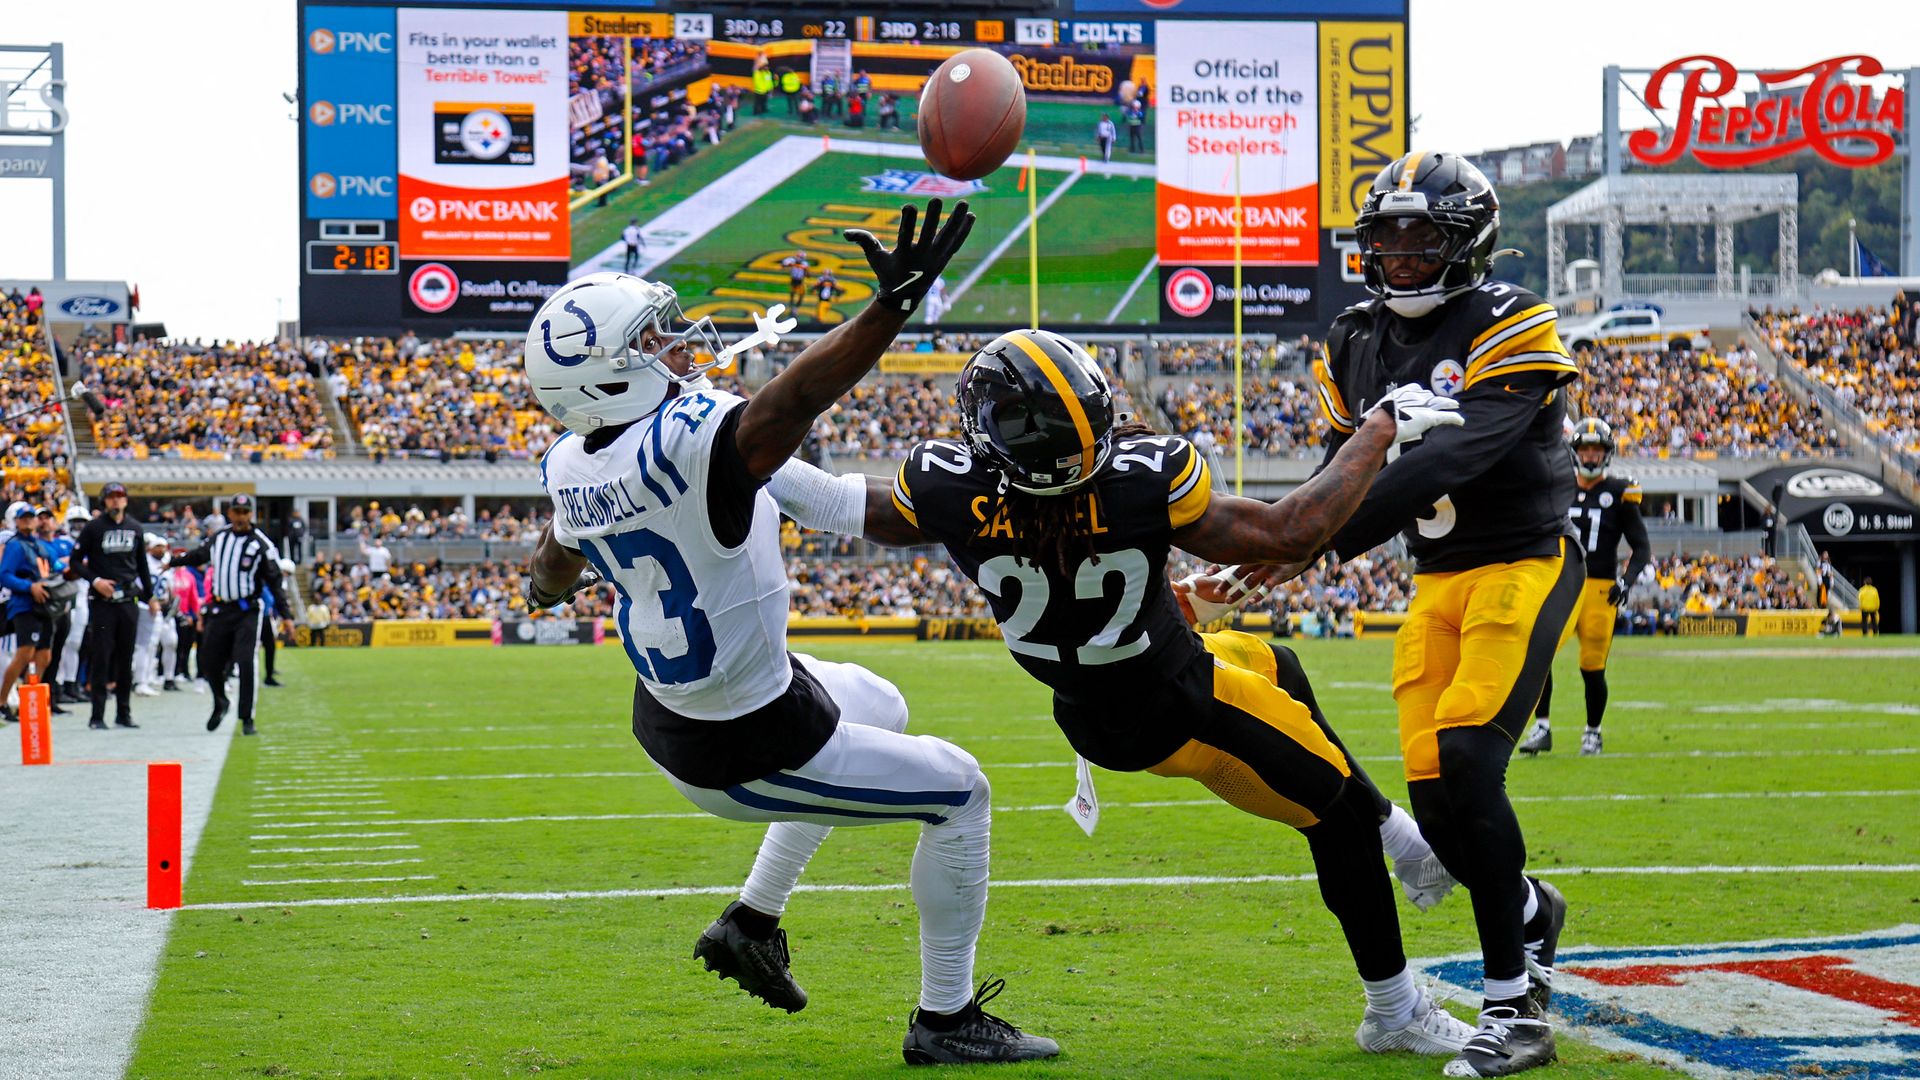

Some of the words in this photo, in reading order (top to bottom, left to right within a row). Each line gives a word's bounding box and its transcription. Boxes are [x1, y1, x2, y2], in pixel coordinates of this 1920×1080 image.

[409, 33, 438, 46] Fits
[443, 33, 458, 46] in
[463, 36, 499, 49] your
[505, 35, 557, 48] wallet
[583, 16, 652, 35] Steelers
[682, 19, 705, 33] 24
[723, 20, 759, 36] 3RD
[770, 20, 783, 36] 8
[824, 21, 846, 38] 22
[880, 22, 916, 38] 3RD
[923, 22, 960, 38] 2:18
[1025, 24, 1047, 39] 16
[1073, 23, 1143, 43] COLTS
[338, 32, 392, 53] PNC
[1330, 37, 1340, 67] LIFE
[427, 51, 480, 64] better
[485, 52, 524, 65] than
[529, 56, 539, 65] a
[1194, 59, 1280, 79] Official
[425, 69, 488, 82] Terrible
[1007, 54, 1113, 92] Steelers
[1170, 85, 1230, 104] Bank
[1236, 86, 1260, 104] of
[1266, 86, 1303, 105] the
[339, 104, 392, 125] PNC
[1330, 71, 1341, 144] CHANGING
[1177, 110, 1297, 133] Pittsburgh
[1187, 136, 1287, 155] Steelers.
[509, 153, 533, 163] VISA
[340, 176, 393, 196] PNC
[1330, 148, 1341, 215] MEDICINE
[1398, 169, 1416, 193] 5
[334, 245, 390, 270] 2:18
[461, 280, 505, 297] South
[1258, 283, 1311, 304] College
[70, 298, 110, 316] Ford
[672, 393, 717, 435] 13
[1112, 437, 1170, 472] 22
[558, 477, 647, 529] TREADWELL
[971, 493, 1108, 538] SAL
[578, 527, 718, 685] 13
[978, 548, 1151, 665] 22
[29, 720, 40, 759] SPORTS
